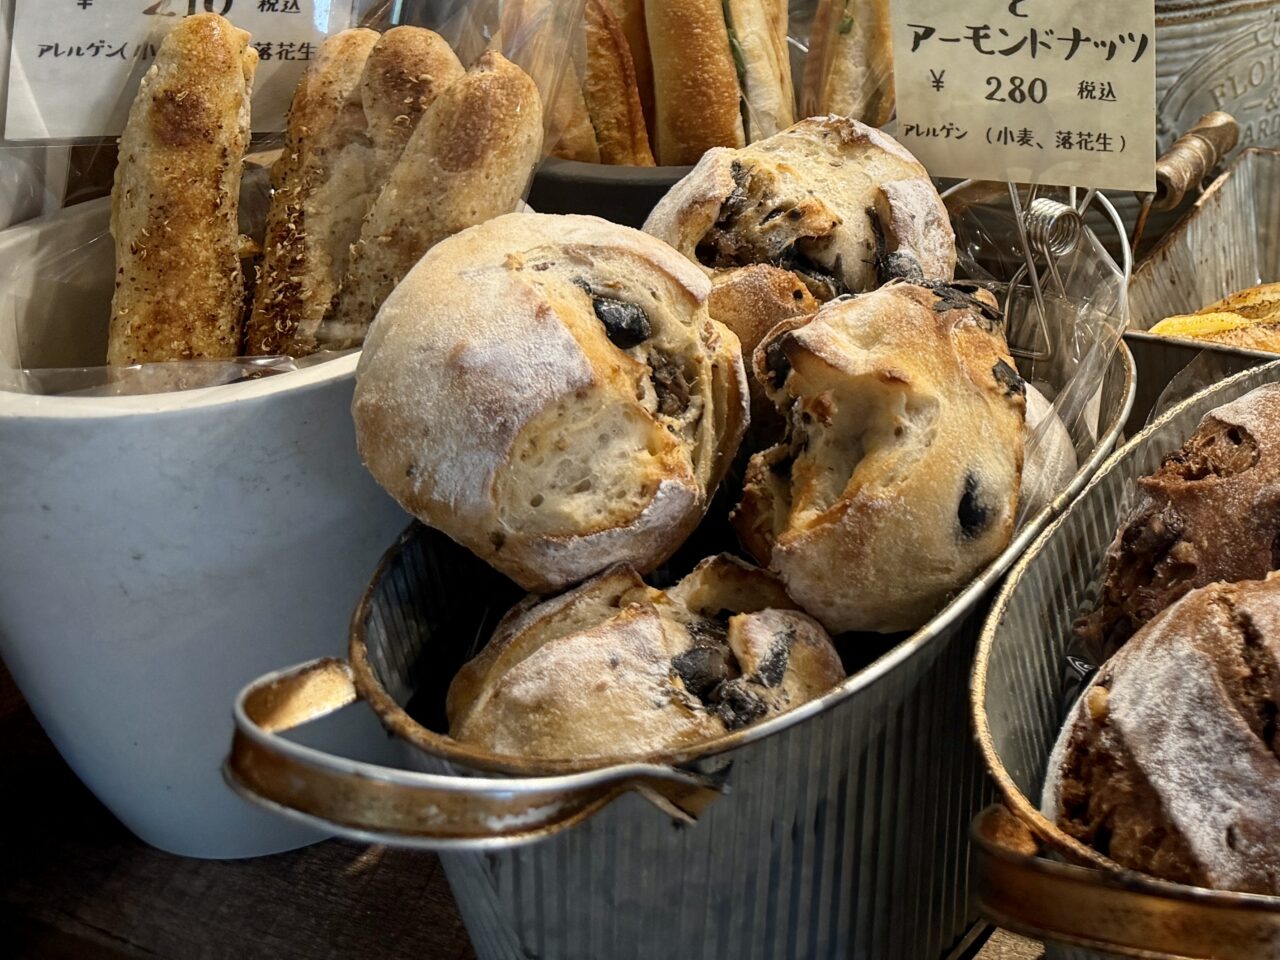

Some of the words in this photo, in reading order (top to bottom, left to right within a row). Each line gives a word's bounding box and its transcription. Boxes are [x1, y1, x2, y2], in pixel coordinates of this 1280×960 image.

[906, 23, 1149, 63] アーモンドナッツ
[930, 68, 945, 92] ¥
[985, 76, 1048, 104] 280
[1077, 79, 1117, 102] 税込
[903, 122, 968, 140] アレルゲン
